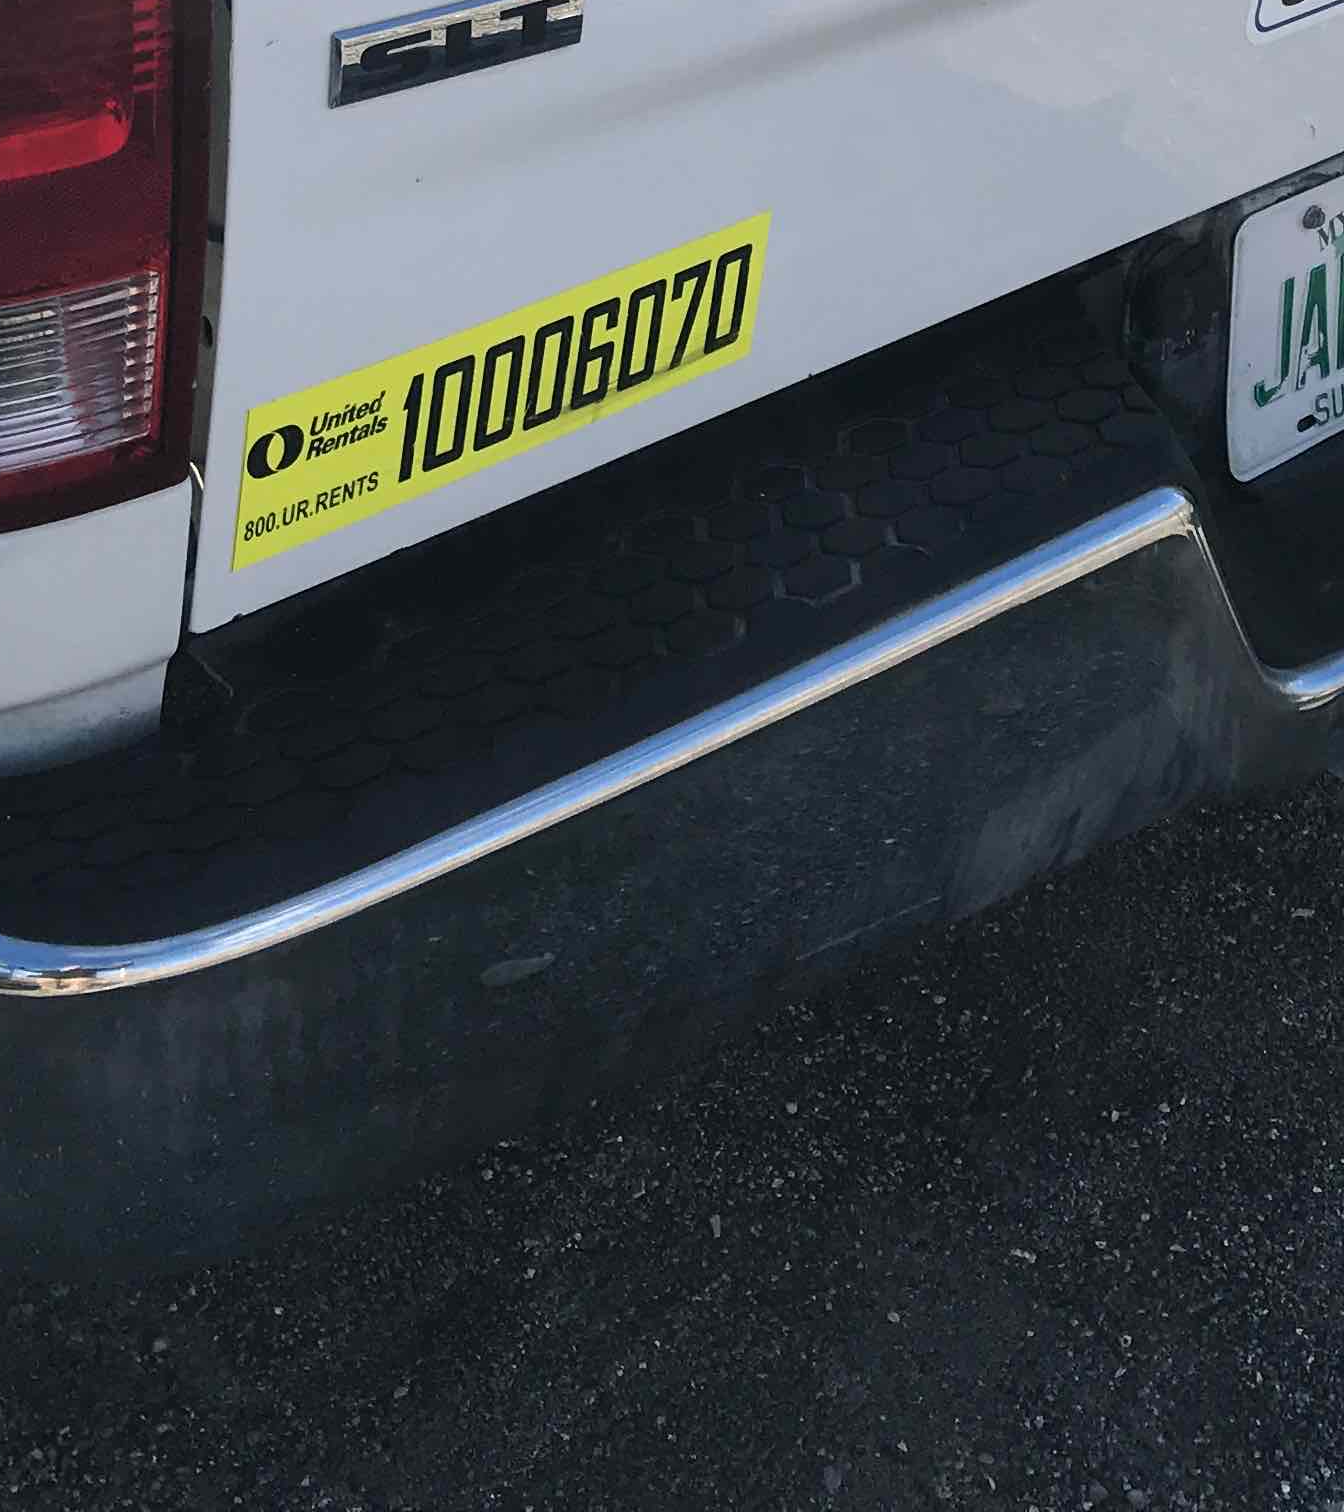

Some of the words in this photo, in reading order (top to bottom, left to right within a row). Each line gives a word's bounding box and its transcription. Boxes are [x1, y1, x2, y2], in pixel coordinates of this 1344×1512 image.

[398, 243, 753, 484] 10006070
[306, 415, 389, 461] Rentals
[309, 390, 386, 436] United
[244, 471, 379, 542] 800.UR.RENTS
